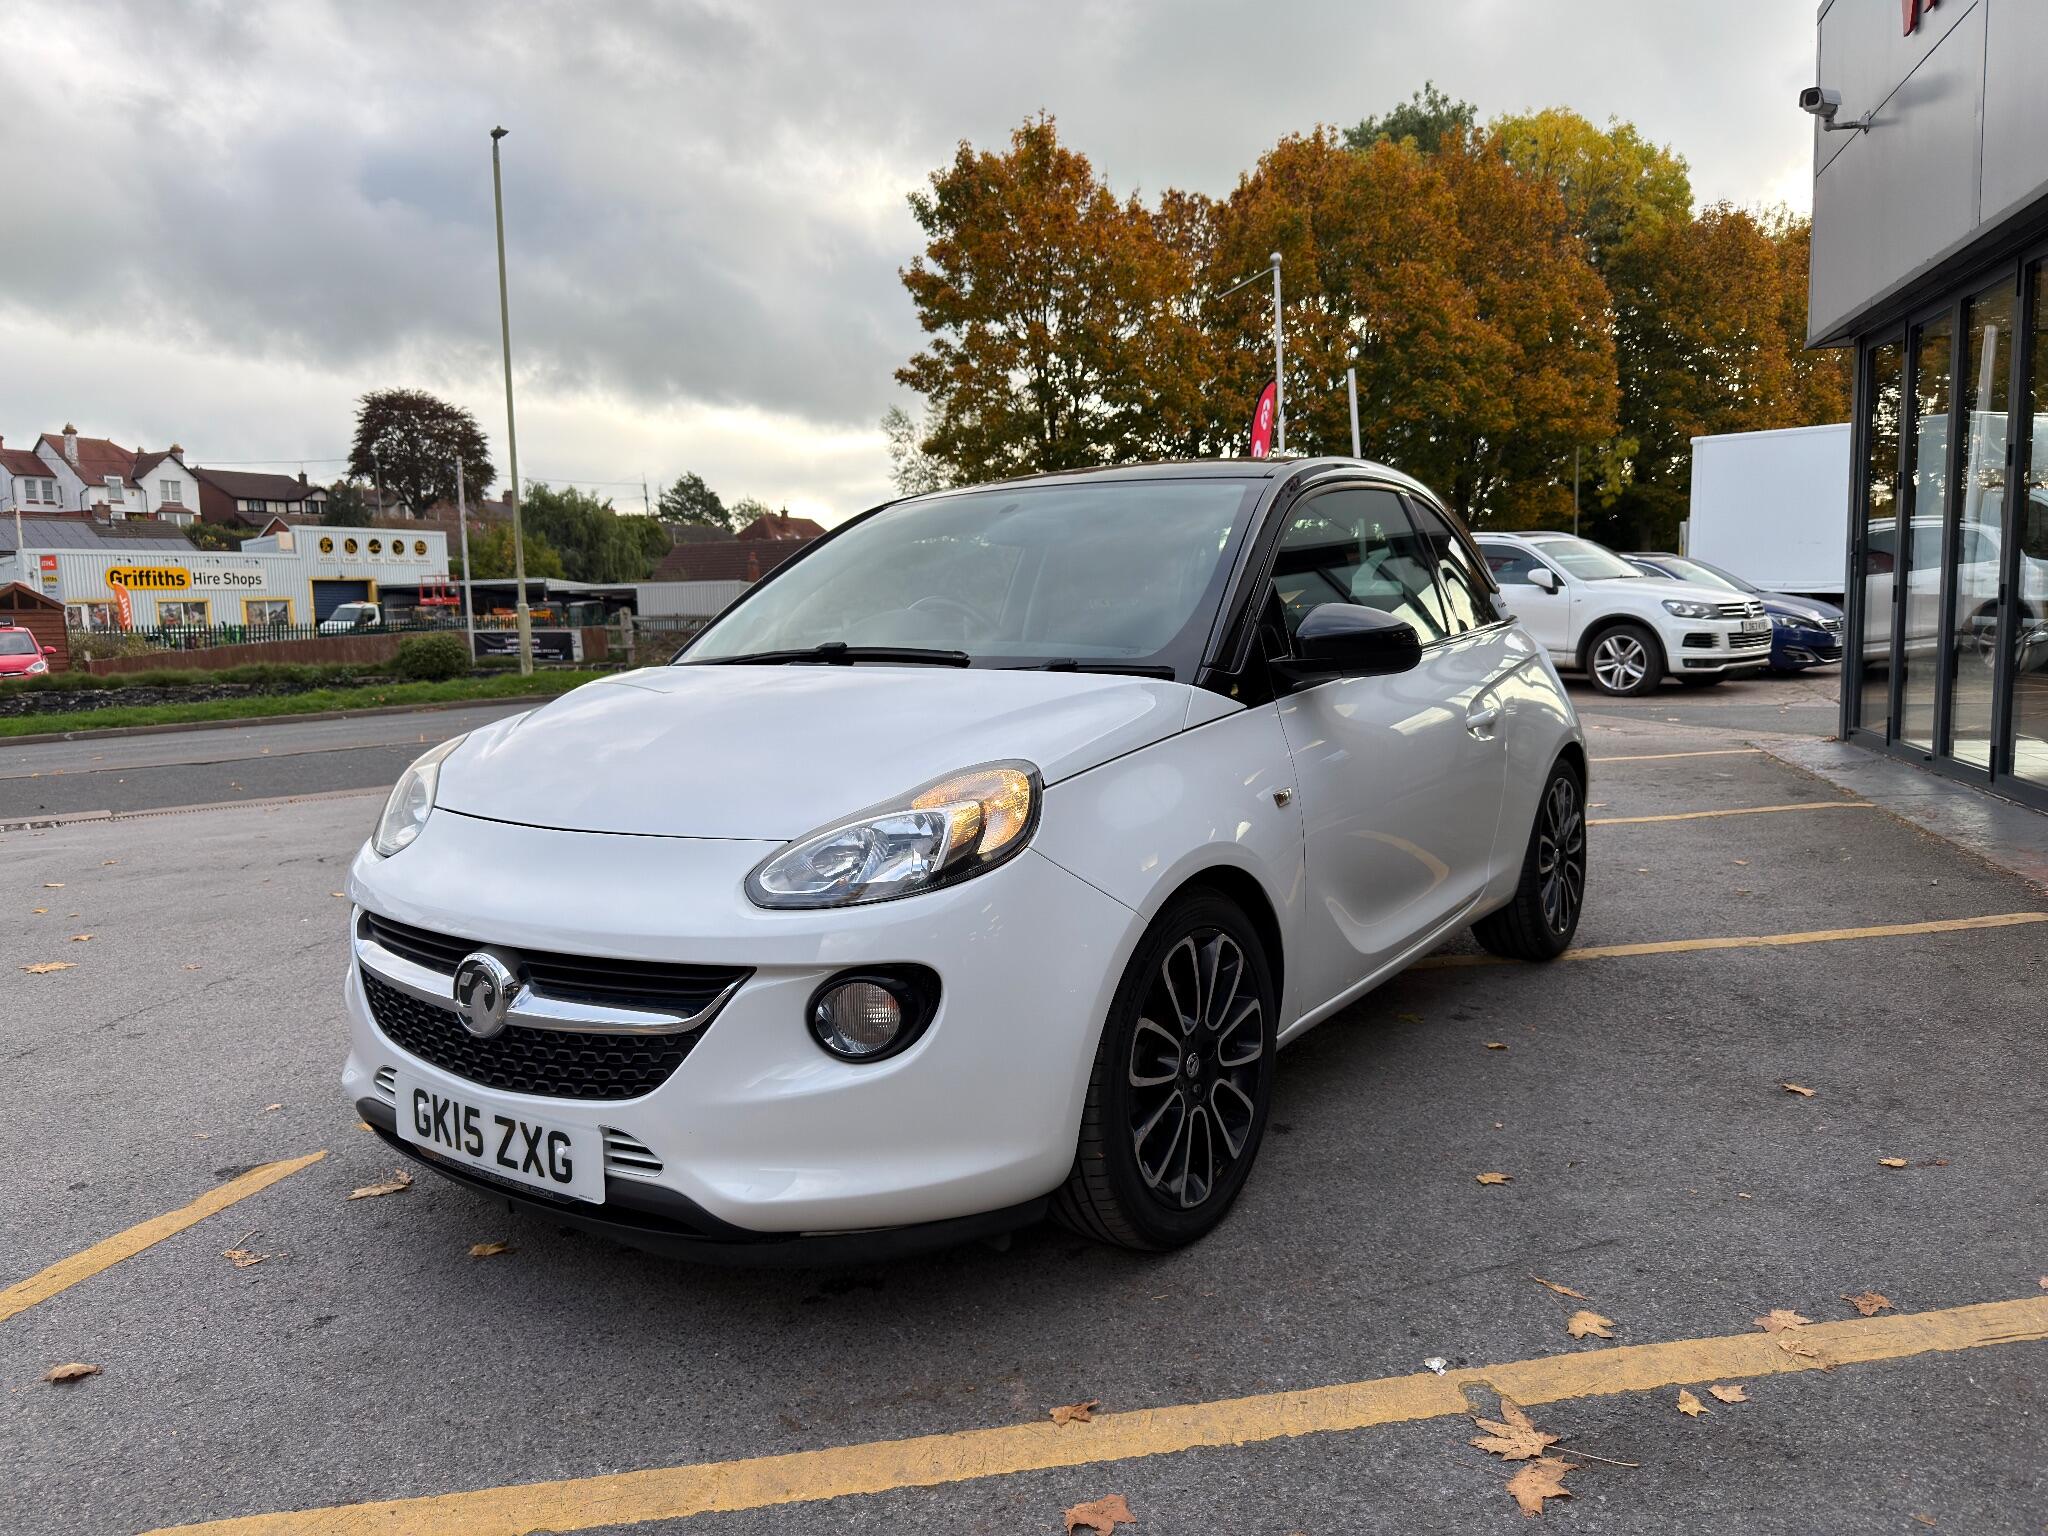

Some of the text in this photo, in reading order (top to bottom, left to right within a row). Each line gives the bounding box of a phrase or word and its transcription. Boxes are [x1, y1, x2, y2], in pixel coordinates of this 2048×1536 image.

[109, 569, 263, 588] Griffiths Hire Shops
[413, 1087, 573, 1184] GK15 ZXG
